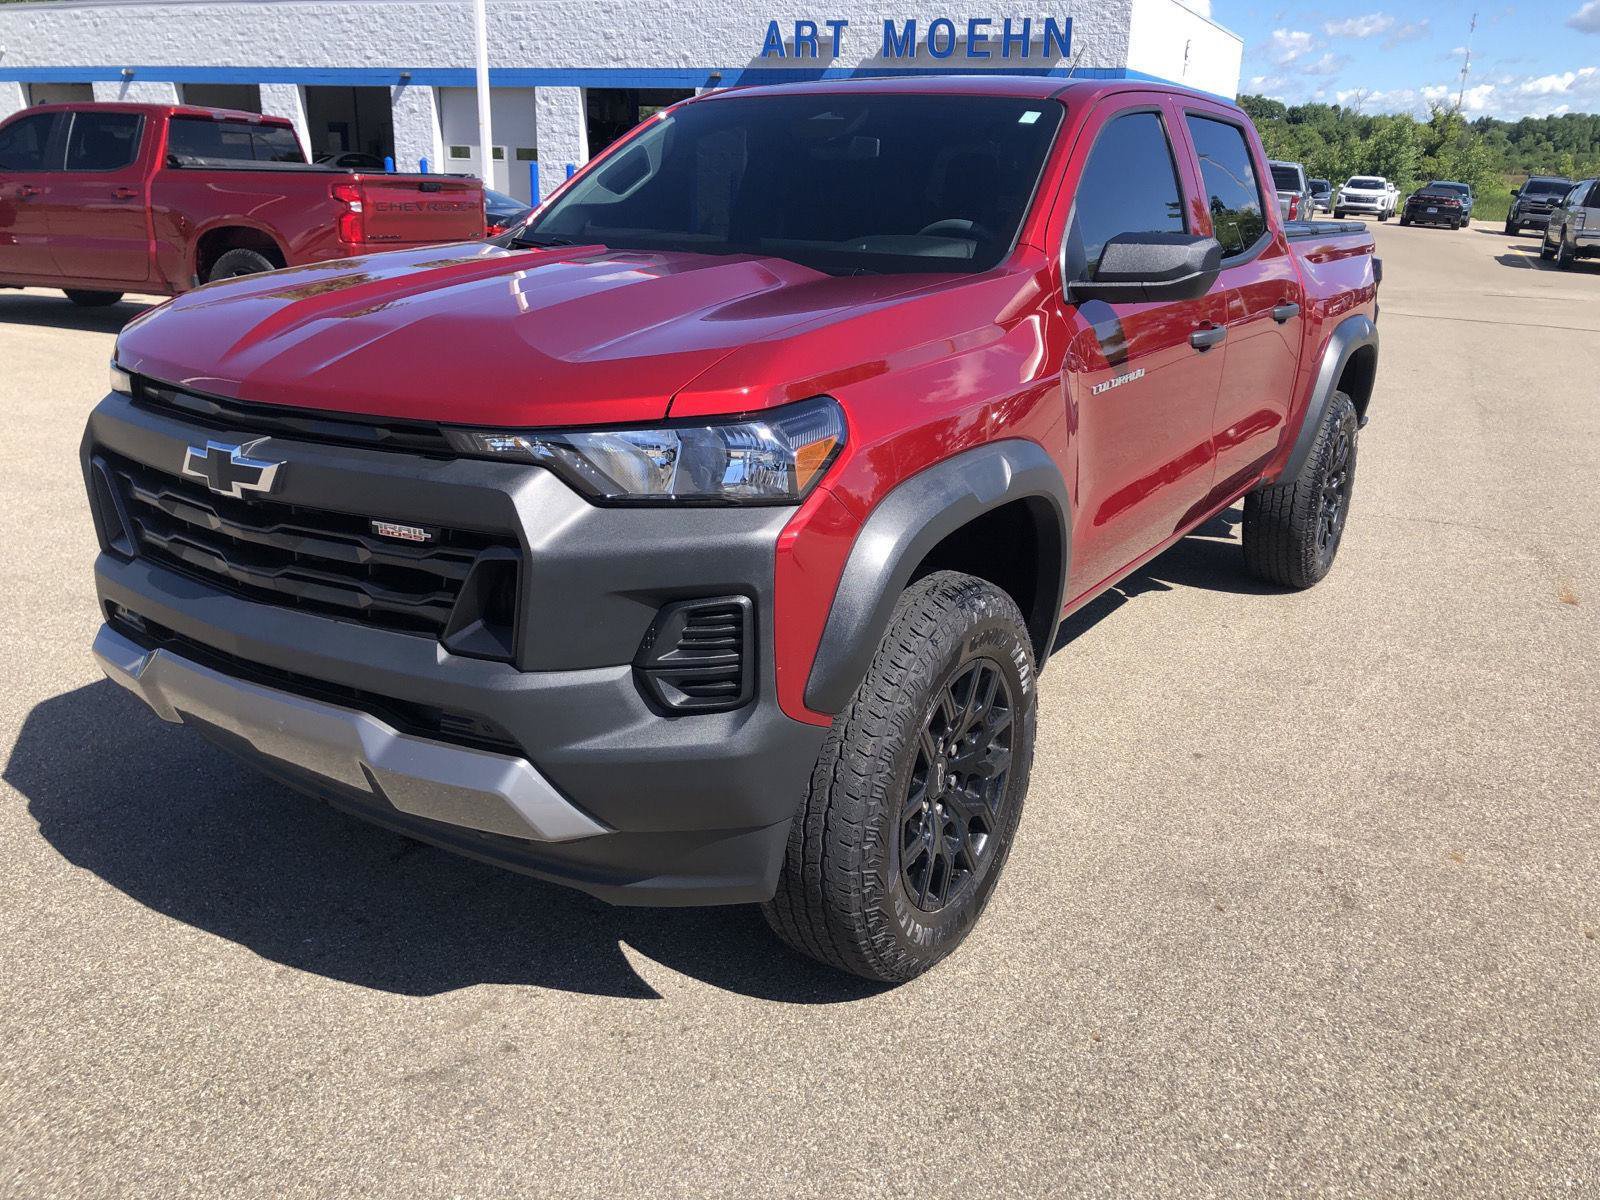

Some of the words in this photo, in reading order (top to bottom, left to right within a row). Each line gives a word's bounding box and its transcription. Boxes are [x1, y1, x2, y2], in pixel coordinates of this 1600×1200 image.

[761, 20, 849, 58] ART
[883, 17, 1073, 59] MOEHN
[1092, 368, 1145, 395] COLORADO
[371, 520, 431, 537] TRAIL
[379, 528, 424, 541] BOSS
